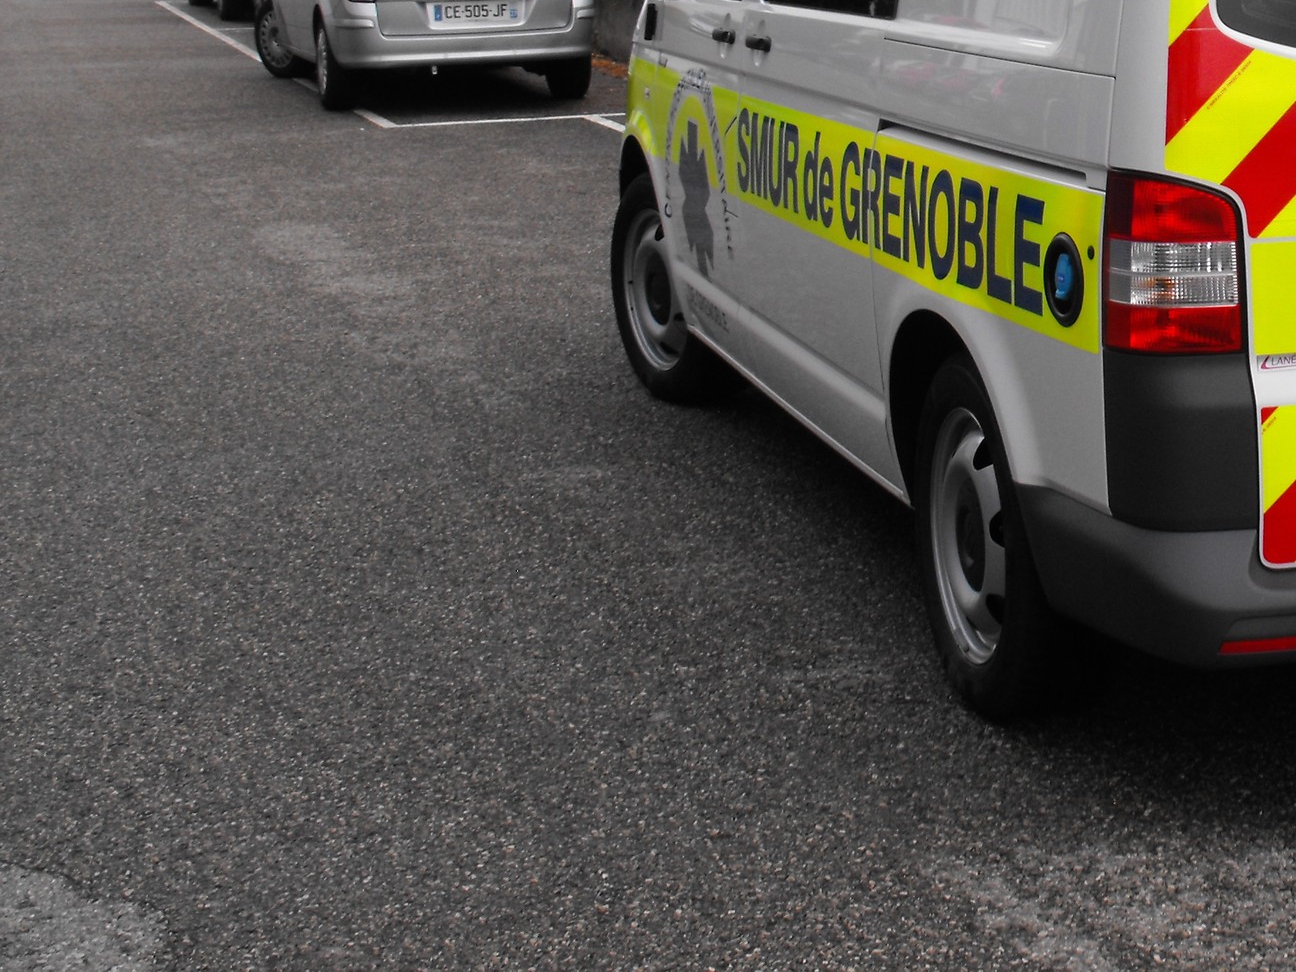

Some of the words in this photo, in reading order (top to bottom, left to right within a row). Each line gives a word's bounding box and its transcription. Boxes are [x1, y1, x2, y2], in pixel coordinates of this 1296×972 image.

[444, 4, 508, 19] CE-505-JF
[737, 107, 800, 215] SMUR
[803, 131, 834, 228] de
[839, 141, 1045, 317] GRENOBLE
